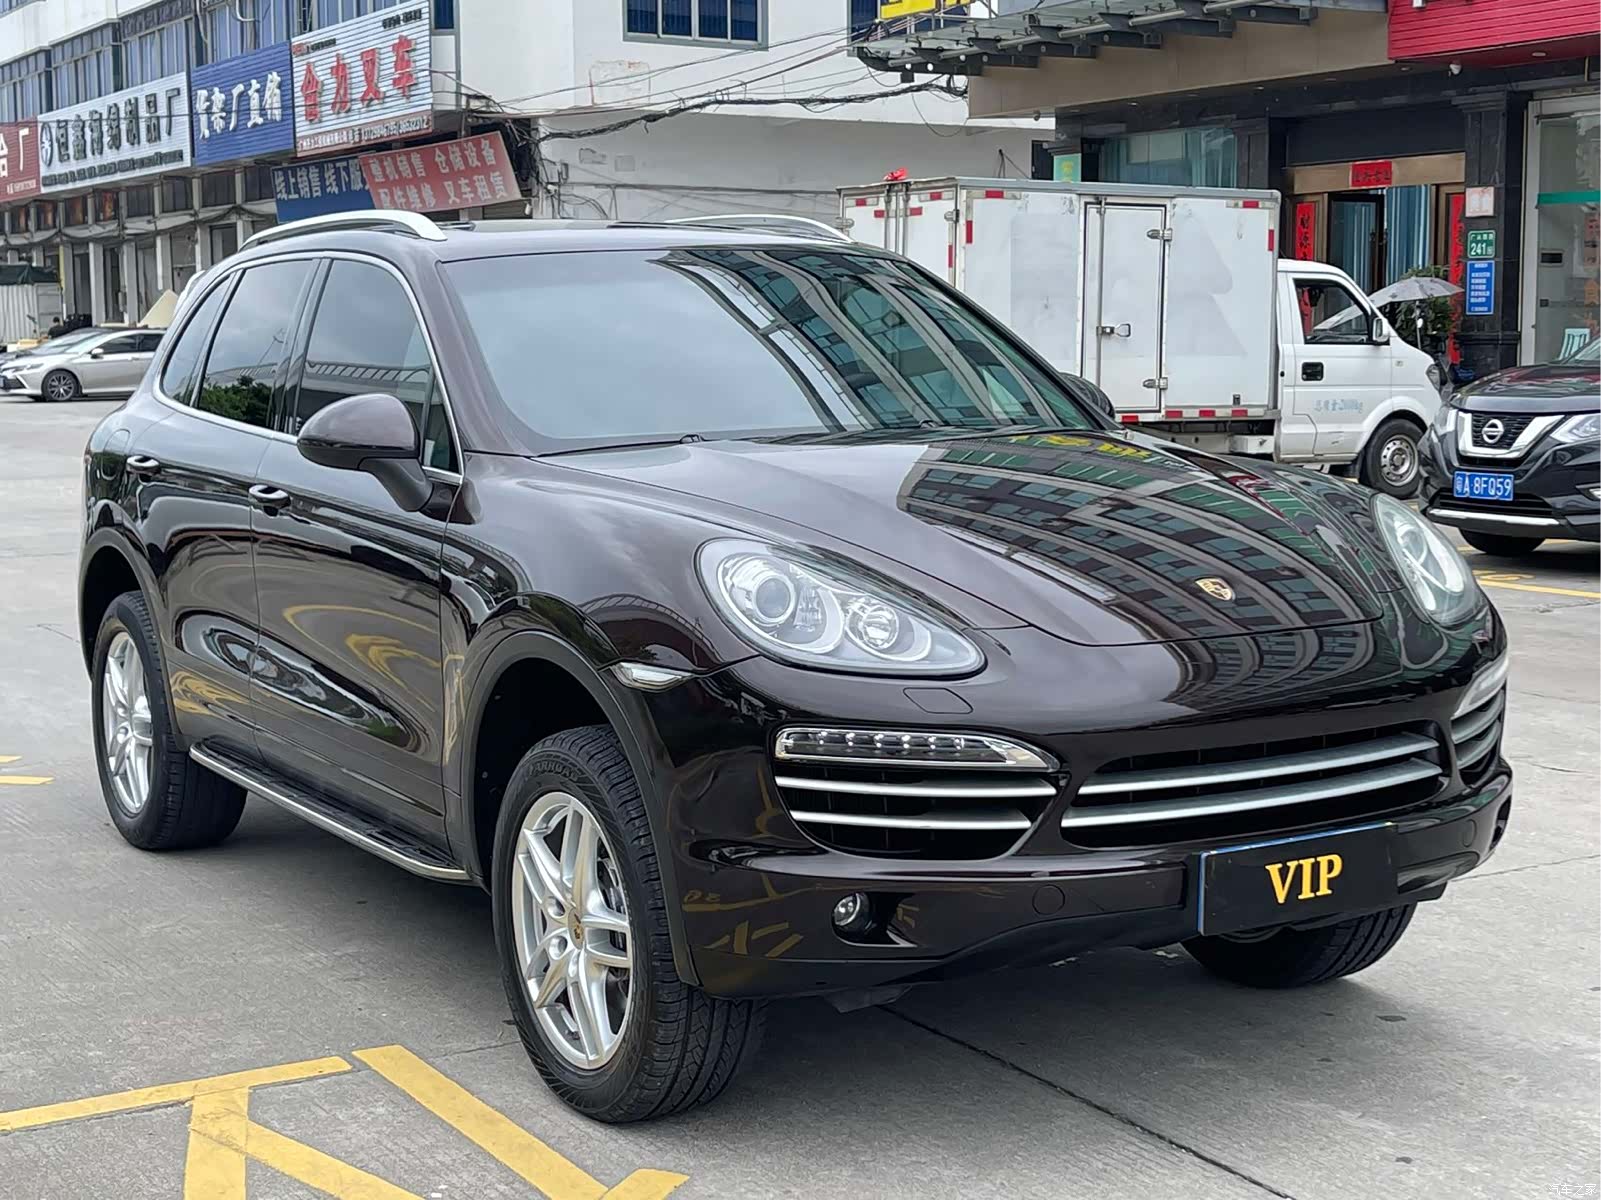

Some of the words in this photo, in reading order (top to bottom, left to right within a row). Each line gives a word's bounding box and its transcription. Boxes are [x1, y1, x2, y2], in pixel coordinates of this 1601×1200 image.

[301, 34, 417, 123] 合力叉车
[274, 164, 321, 201] 线上销售
[324, 157, 369, 196] 线下服
[369, 153, 427, 184] 整机销售
[434, 138, 497, 173] 仓储设备
[446, 171, 509, 205] 叉车租赁
[1265, 853, 1343, 904] VIP
